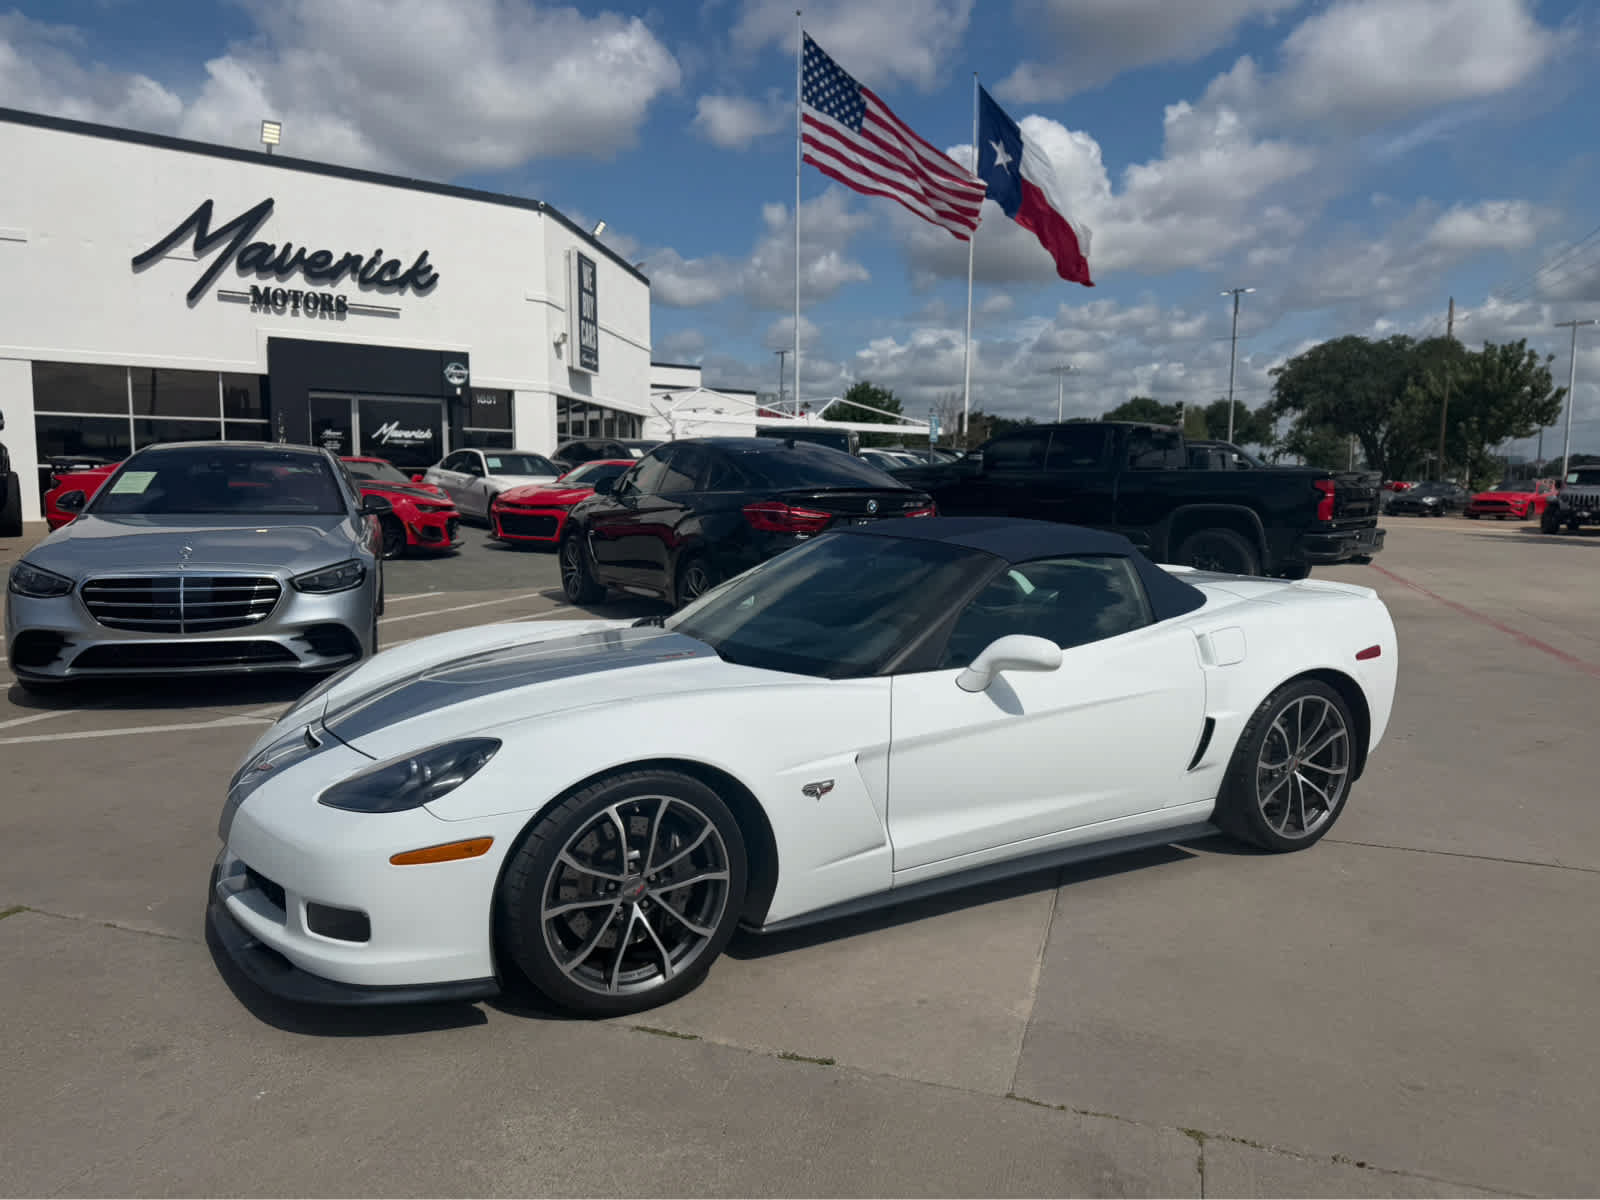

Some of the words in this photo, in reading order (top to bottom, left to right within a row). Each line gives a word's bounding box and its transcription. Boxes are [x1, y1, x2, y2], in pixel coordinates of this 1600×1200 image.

[131, 197, 440, 304] Maverick
[249, 284, 349, 313] MOTORS
[372, 421, 432, 444] Maverick
